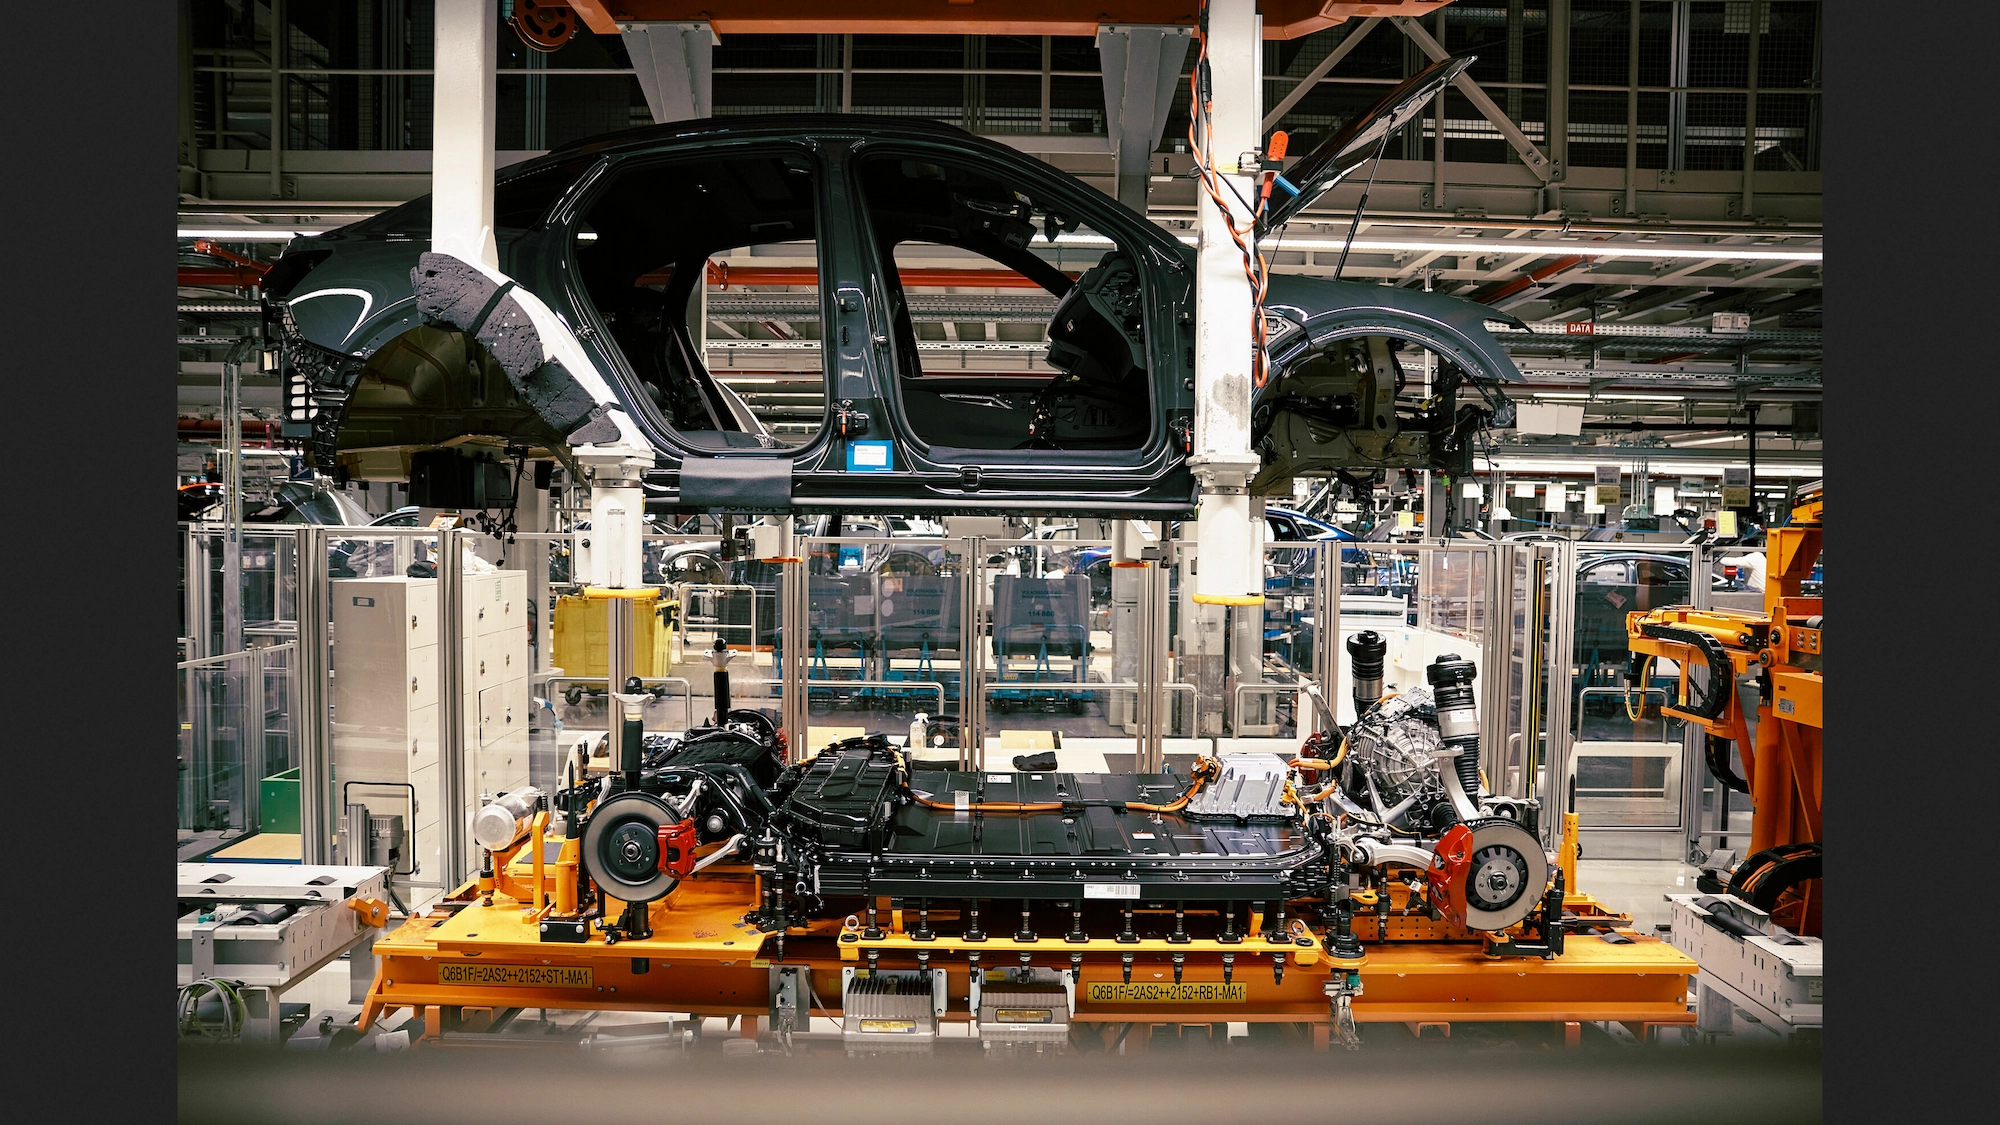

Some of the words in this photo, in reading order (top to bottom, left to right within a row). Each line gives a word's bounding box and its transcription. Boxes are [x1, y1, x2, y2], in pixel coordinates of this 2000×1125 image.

[1570, 323, 1591, 333] DATA
[442, 966, 589, 985] Q6B1F/=2AS2++2152+ST1-MA1
[1092, 984, 1243, 1000] Q6B1F/=2AS2++2152+RB1-MA1
